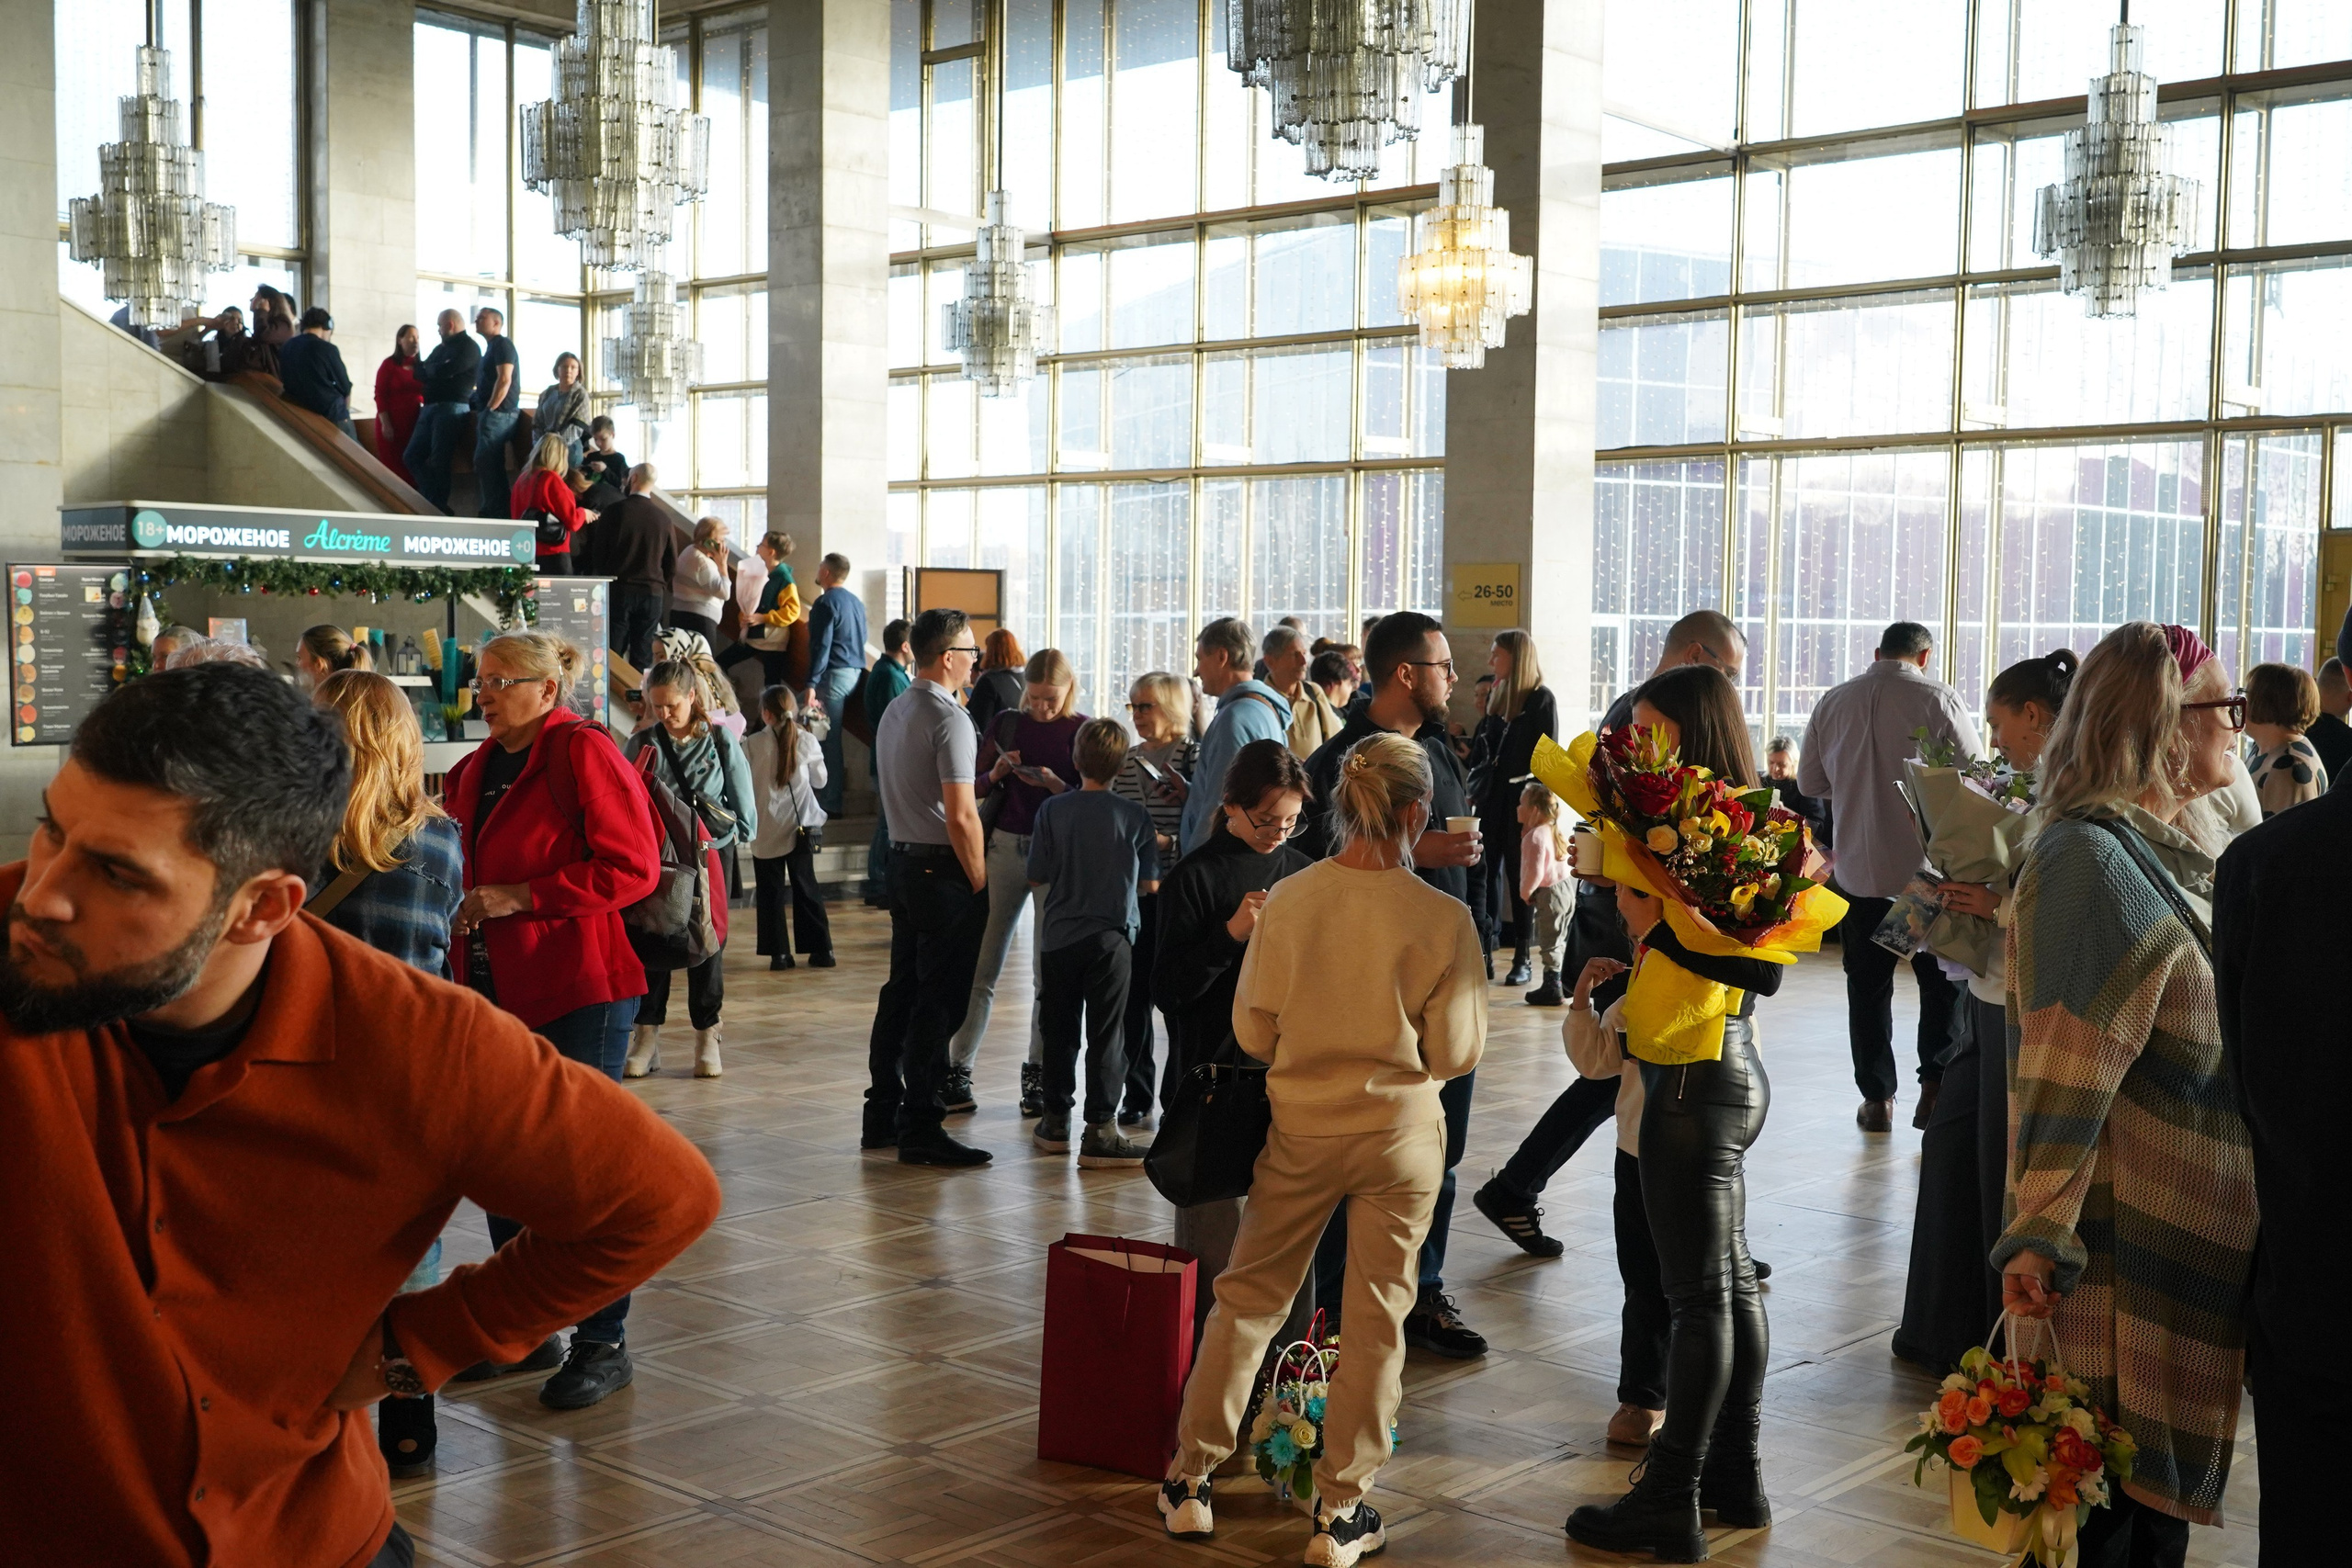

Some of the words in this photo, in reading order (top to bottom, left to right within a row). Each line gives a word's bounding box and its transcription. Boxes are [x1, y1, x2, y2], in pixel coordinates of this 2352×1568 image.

[62, 524, 126, 542] МОРОЖЕНОЕ
[137, 521, 164, 536] 18+
[166, 525, 290, 548] МОРОЖЕНОЕ
[403, 536, 511, 557] МОРОЖЕНОЕ
[1474, 584, 1513, 599] 26-50
